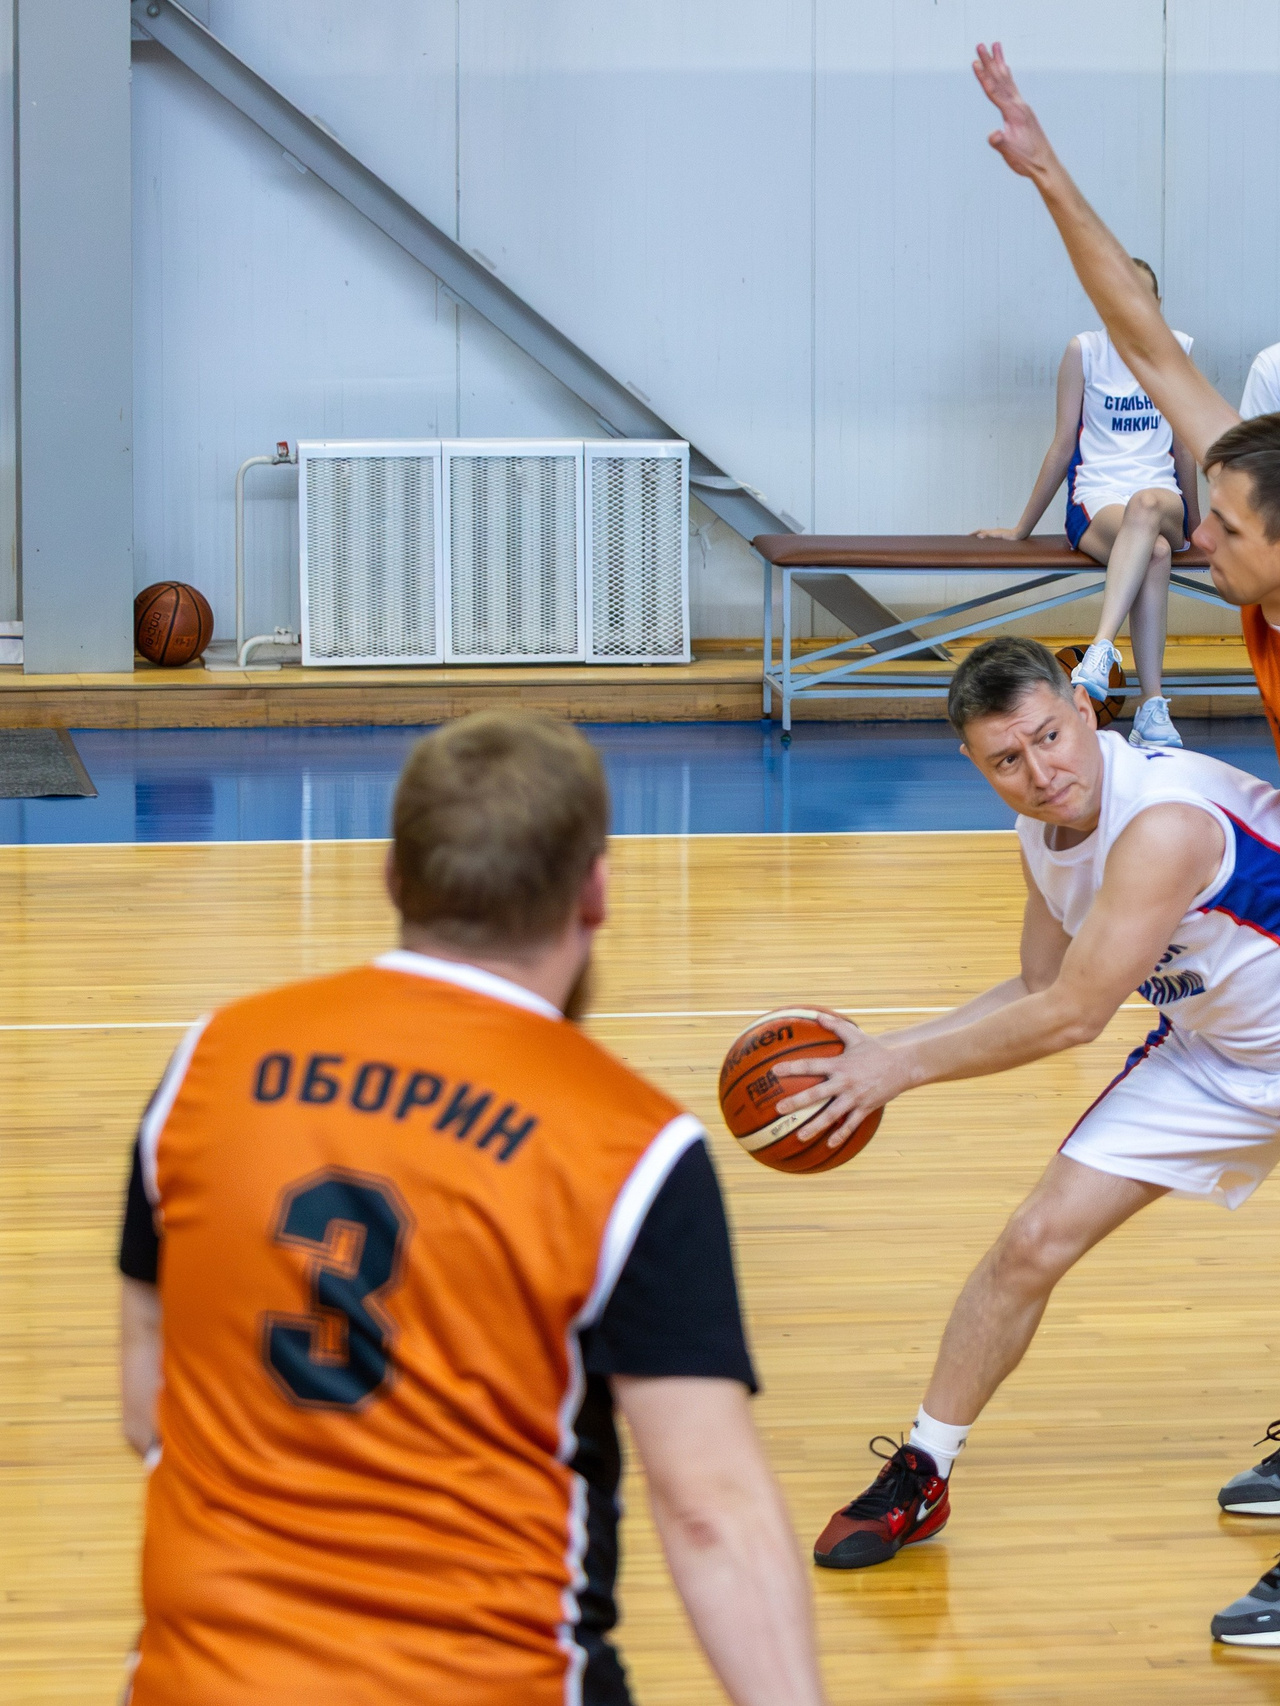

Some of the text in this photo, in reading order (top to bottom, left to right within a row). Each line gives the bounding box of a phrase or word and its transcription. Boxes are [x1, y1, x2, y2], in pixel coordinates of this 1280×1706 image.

[1105, 395, 1153, 411] СТАЛЬН
[1112, 415, 1162, 432] МЯКИШ
[253, 1051, 538, 1164] ОБОРИН
[260, 1164, 416, 1413] 3
